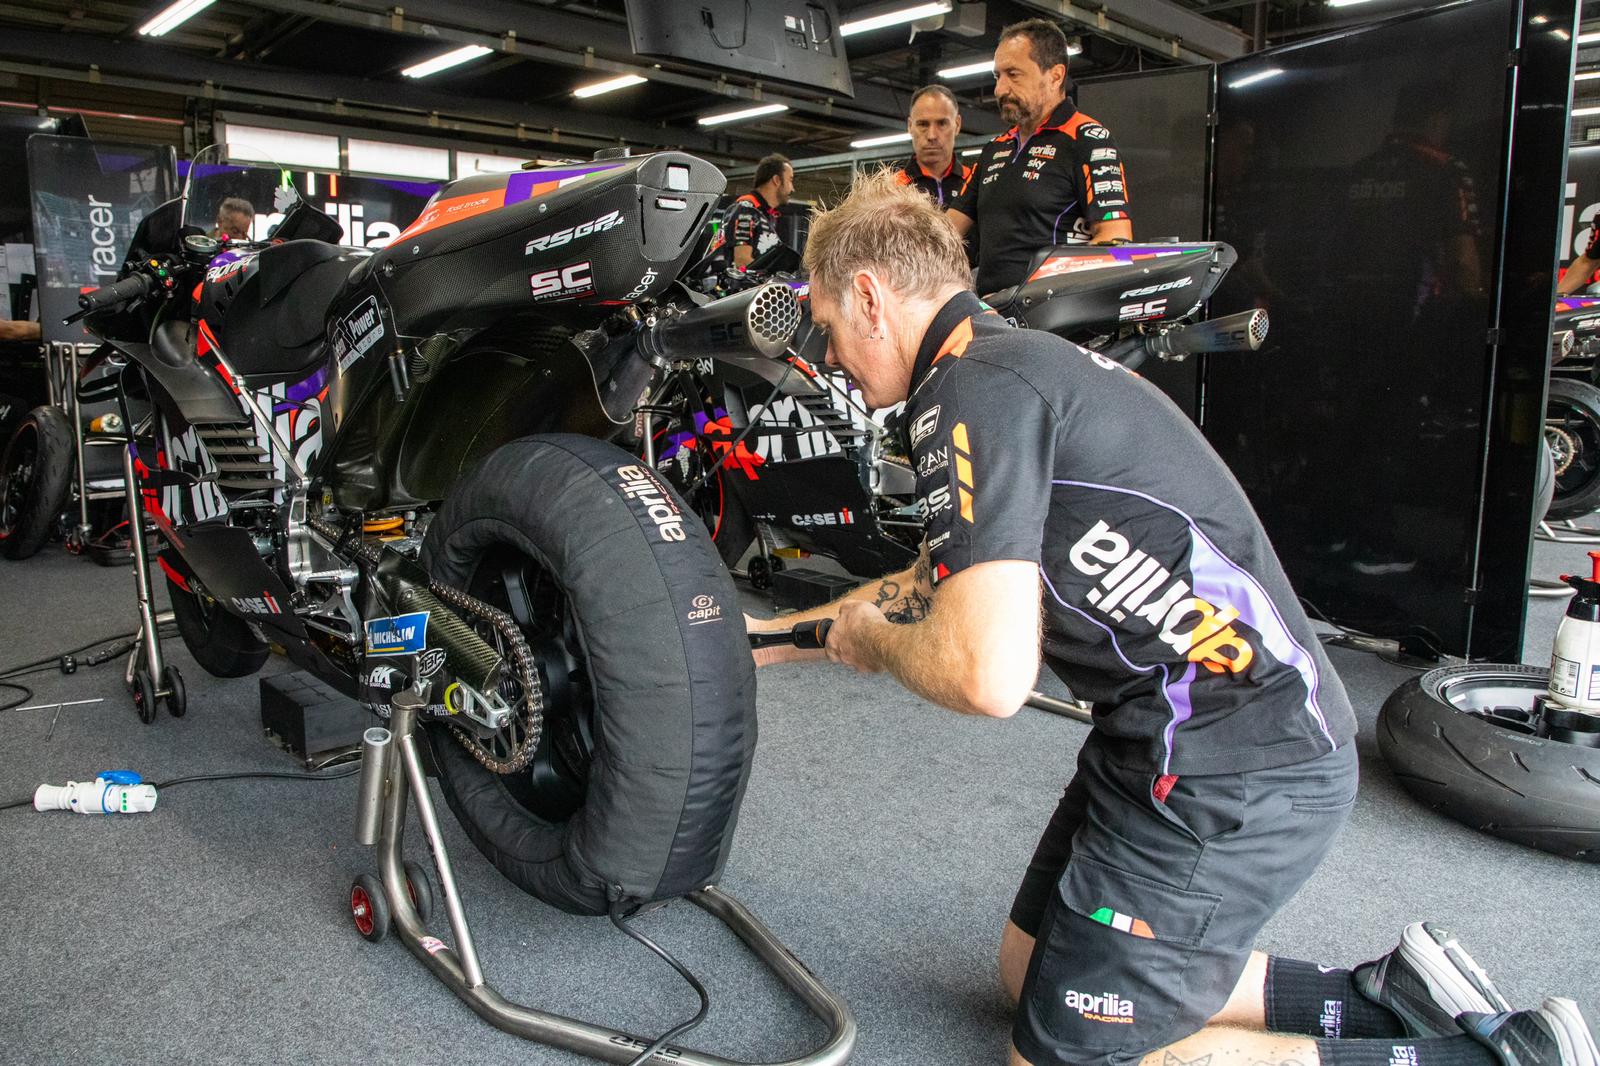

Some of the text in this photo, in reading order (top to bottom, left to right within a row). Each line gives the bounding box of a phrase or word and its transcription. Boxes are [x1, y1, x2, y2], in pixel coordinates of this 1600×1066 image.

[88, 194, 118, 276] racer
[531, 262, 593, 295] SC
[534, 286, 593, 301] PROJECT
[1119, 299, 1168, 320] SC
[348, 307, 375, 340] Power
[617, 464, 687, 542] aprilia
[791, 512, 837, 526] CASE
[1069, 519, 1254, 674] aprilia
[688, 605, 721, 620] capit
[369, 665, 398, 684] RK
[1065, 990, 1134, 1017] aprilia
[1083, 1012, 1135, 1024] RACING
